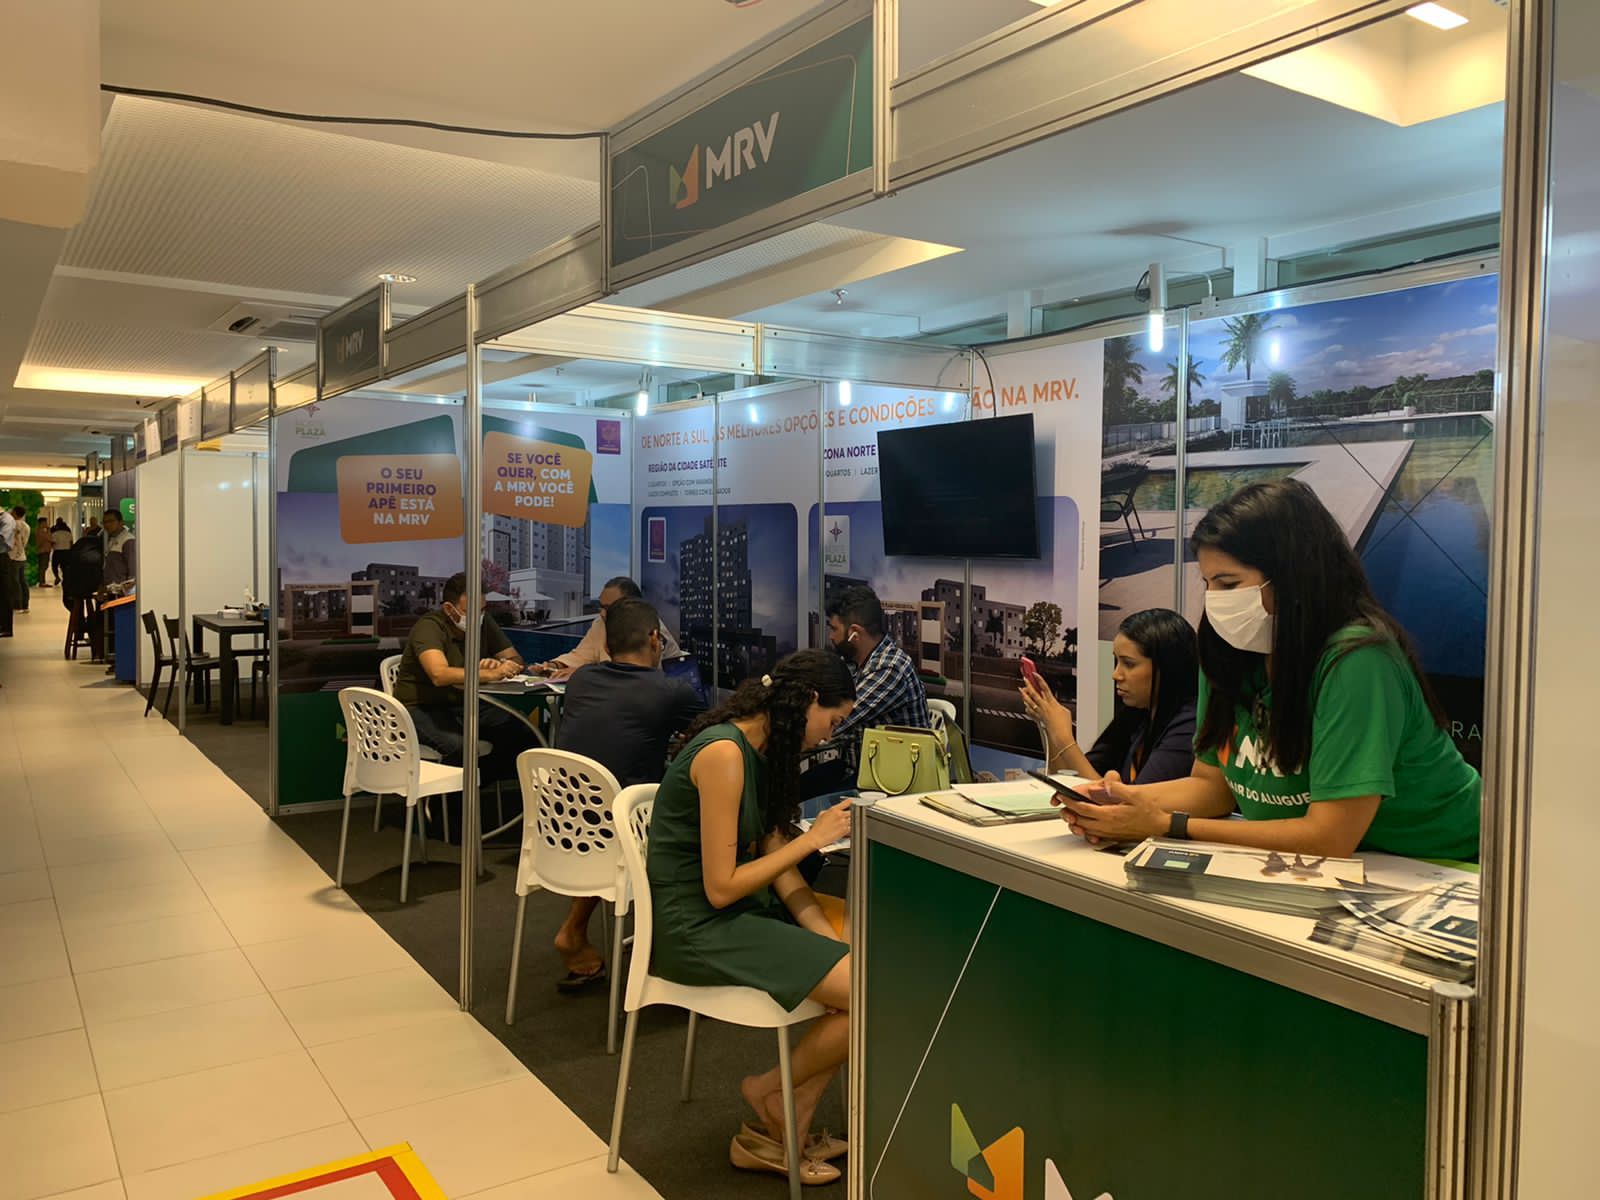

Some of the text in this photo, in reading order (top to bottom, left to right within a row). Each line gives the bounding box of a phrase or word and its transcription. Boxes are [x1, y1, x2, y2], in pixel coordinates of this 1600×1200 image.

[705, 111, 780, 190] MRV
[641, 435, 652, 449] DE
[653, 431, 681, 447] NORTE
[683, 431, 689, 445] A
[838, 409, 846, 427] E
[848, 395, 936, 425] CONDIÇÕES
[1001, 385, 1028, 407] NA
[1032, 377, 1080, 404] MRV.
[847, 444, 877, 458] NORTE
[507, 451, 561, 466] SE VOCÊ
[677, 459, 698, 471] CIDADE
[699, 457, 728, 470] SATÉITE
[380, 467, 423, 480] O SEU
[497, 466, 571, 480] QUER, COM
[825, 467, 851, 478] QUARTOS
[366, 482, 437, 496] PRIMEIRO
[494, 480, 575, 494] A MRV VOCÊ
[368, 496, 435, 511] APÊ ESTÁ
[515, 495, 555, 508] PODE!
[373, 512, 430, 526] NA MRV
[1246, 787, 1260, 802] DO
[1261, 791, 1312, 807] ALUGUE
